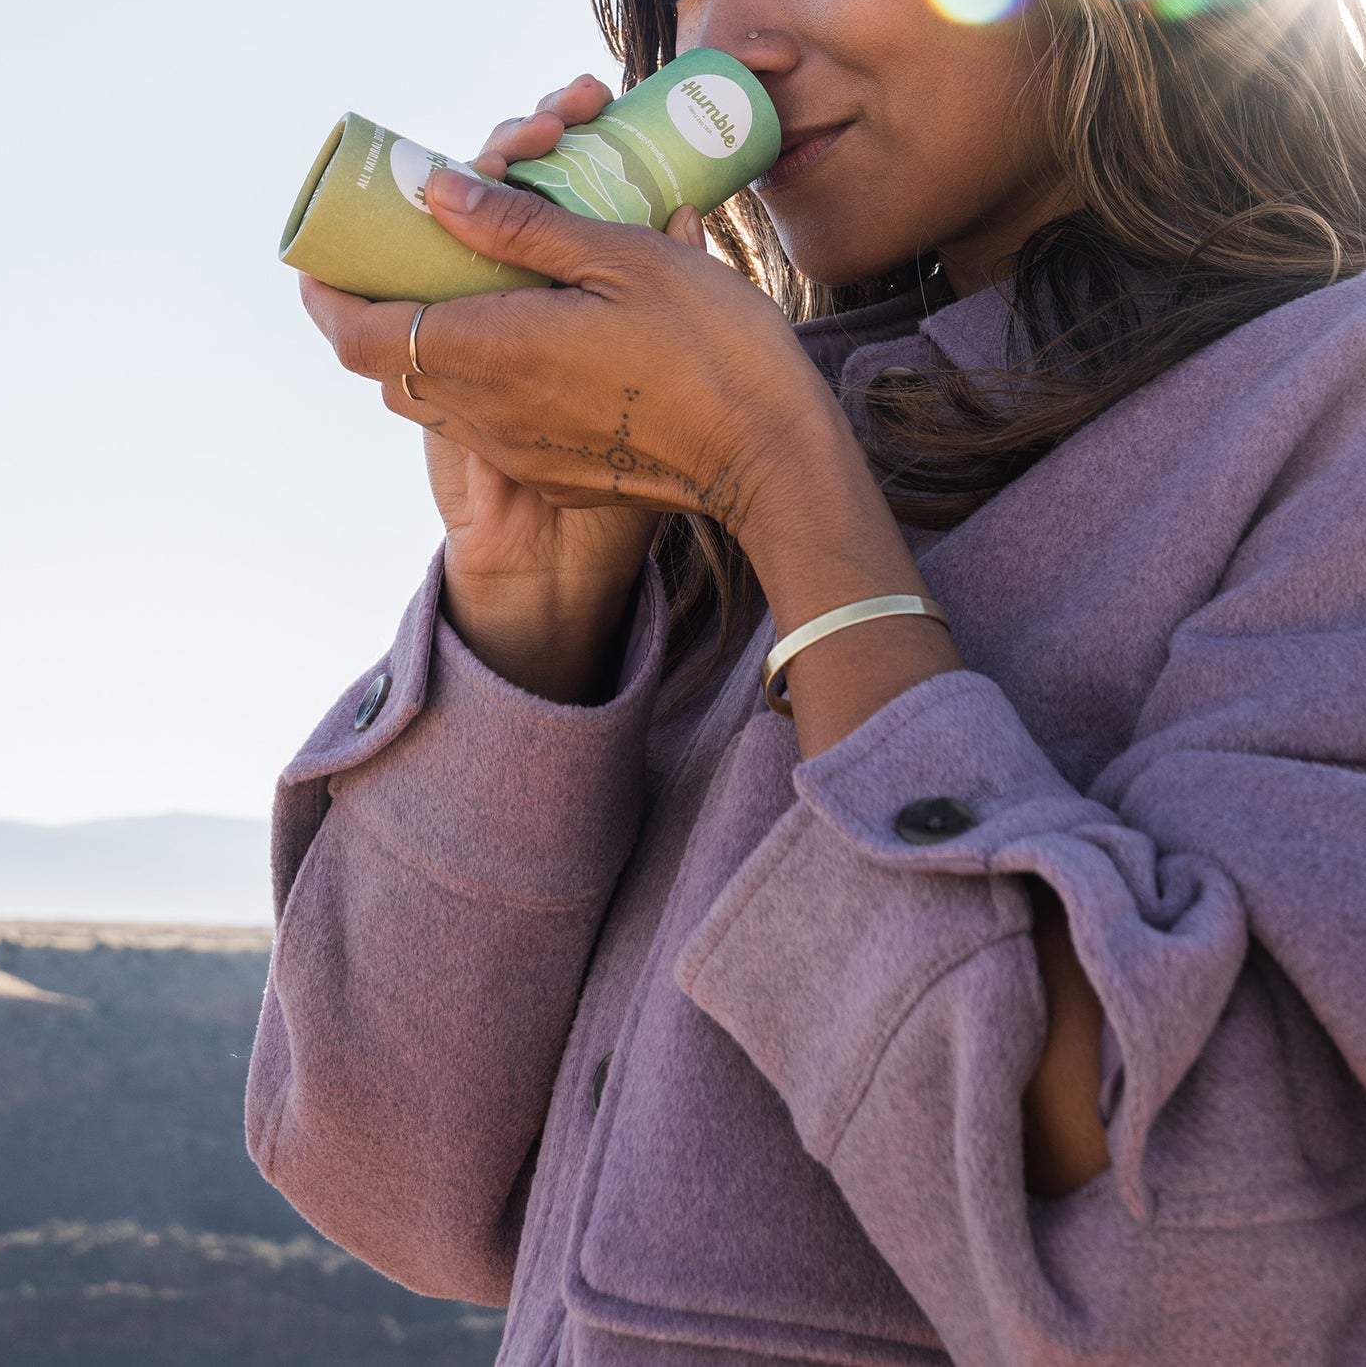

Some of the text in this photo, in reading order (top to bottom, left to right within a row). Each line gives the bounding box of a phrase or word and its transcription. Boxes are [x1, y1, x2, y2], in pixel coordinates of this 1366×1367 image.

[680, 80, 736, 149] Humble
[363, 141, 383, 173] NATURAL
[356, 173, 371, 190] ALL
